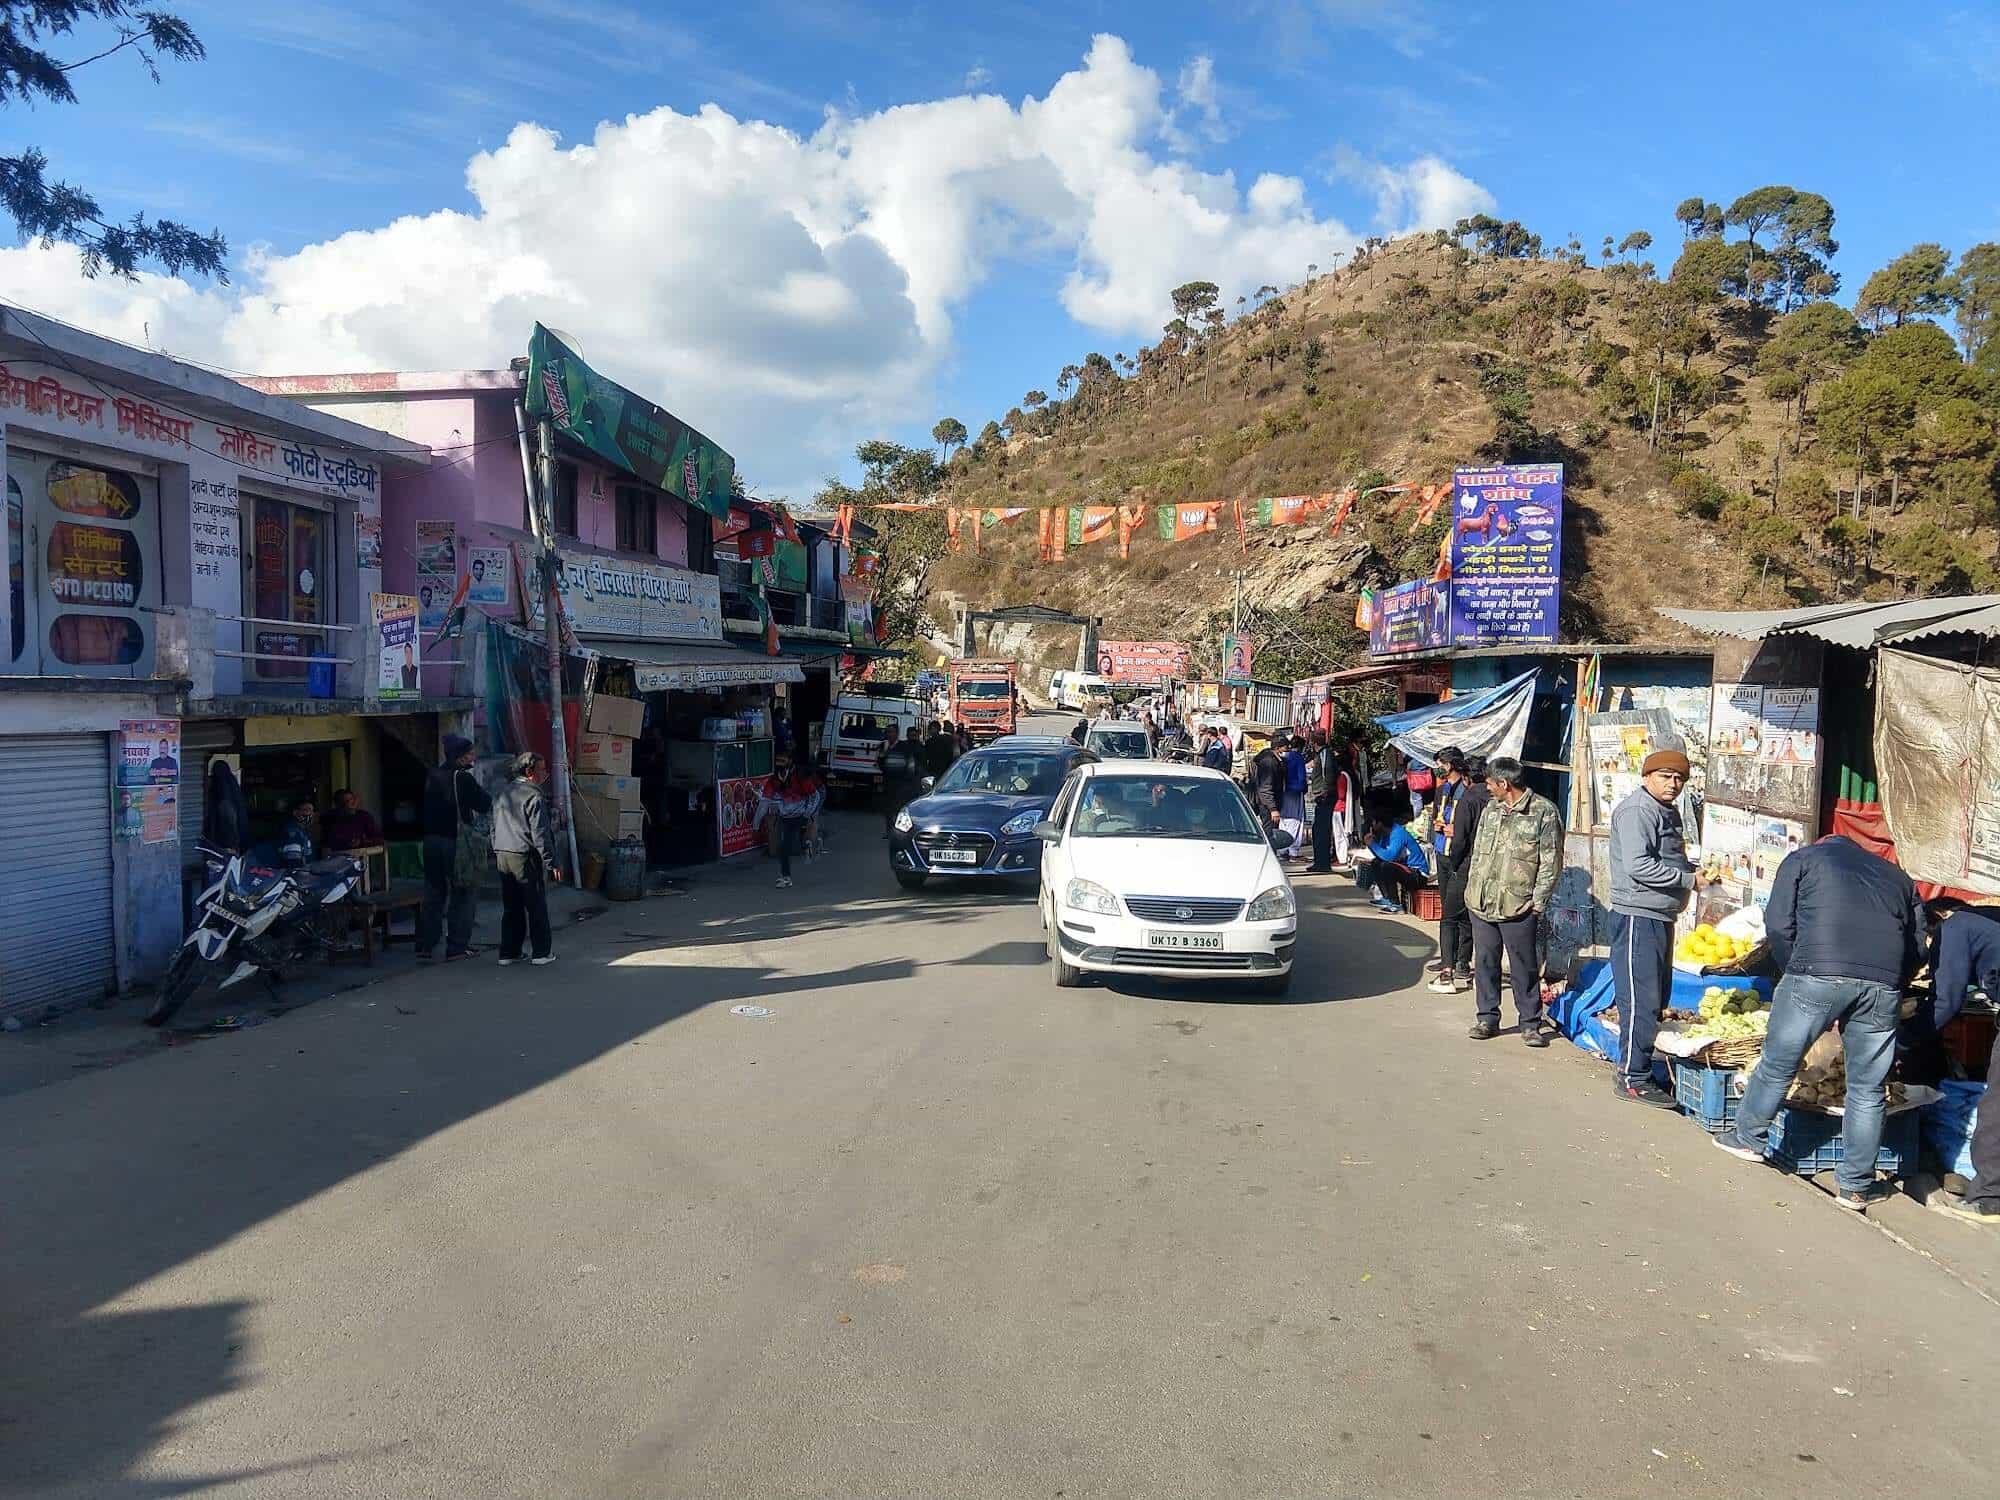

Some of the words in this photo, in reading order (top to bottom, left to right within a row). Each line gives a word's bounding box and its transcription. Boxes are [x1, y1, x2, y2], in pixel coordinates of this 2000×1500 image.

[216, 426, 277, 464] मोहित
[281, 444, 321, 479] फोटो
[1182, 937, 1189, 946] B
[1193, 937, 1219, 947] 3360
